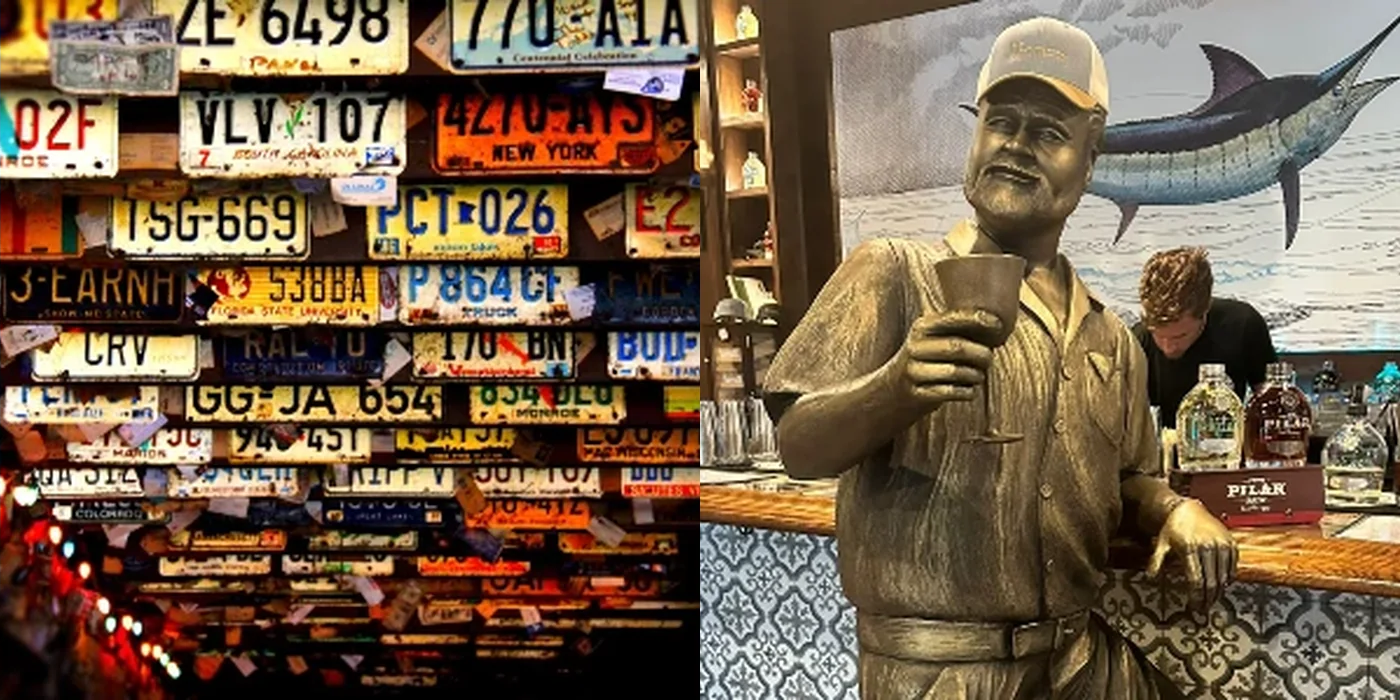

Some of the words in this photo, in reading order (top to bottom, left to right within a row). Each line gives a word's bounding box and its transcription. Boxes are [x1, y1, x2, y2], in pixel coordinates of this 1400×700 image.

[260, 0, 390, 46] 6498
[574, 51, 638, 62] Celebration
[196, 98, 278, 145] VLV
[313, 98, 391, 143] 107
[491, 143, 536, 162] NEW
[545, 141, 598, 160] YORK
[479, 187, 556, 235] 026
[10, 267, 175, 305] 3-EARNH
[461, 306, 519, 318] TRUCK
[84, 333, 150, 366] CRV
[1264, 417, 1313, 435] PILAR
[1226, 481, 1287, 498] PILAR
